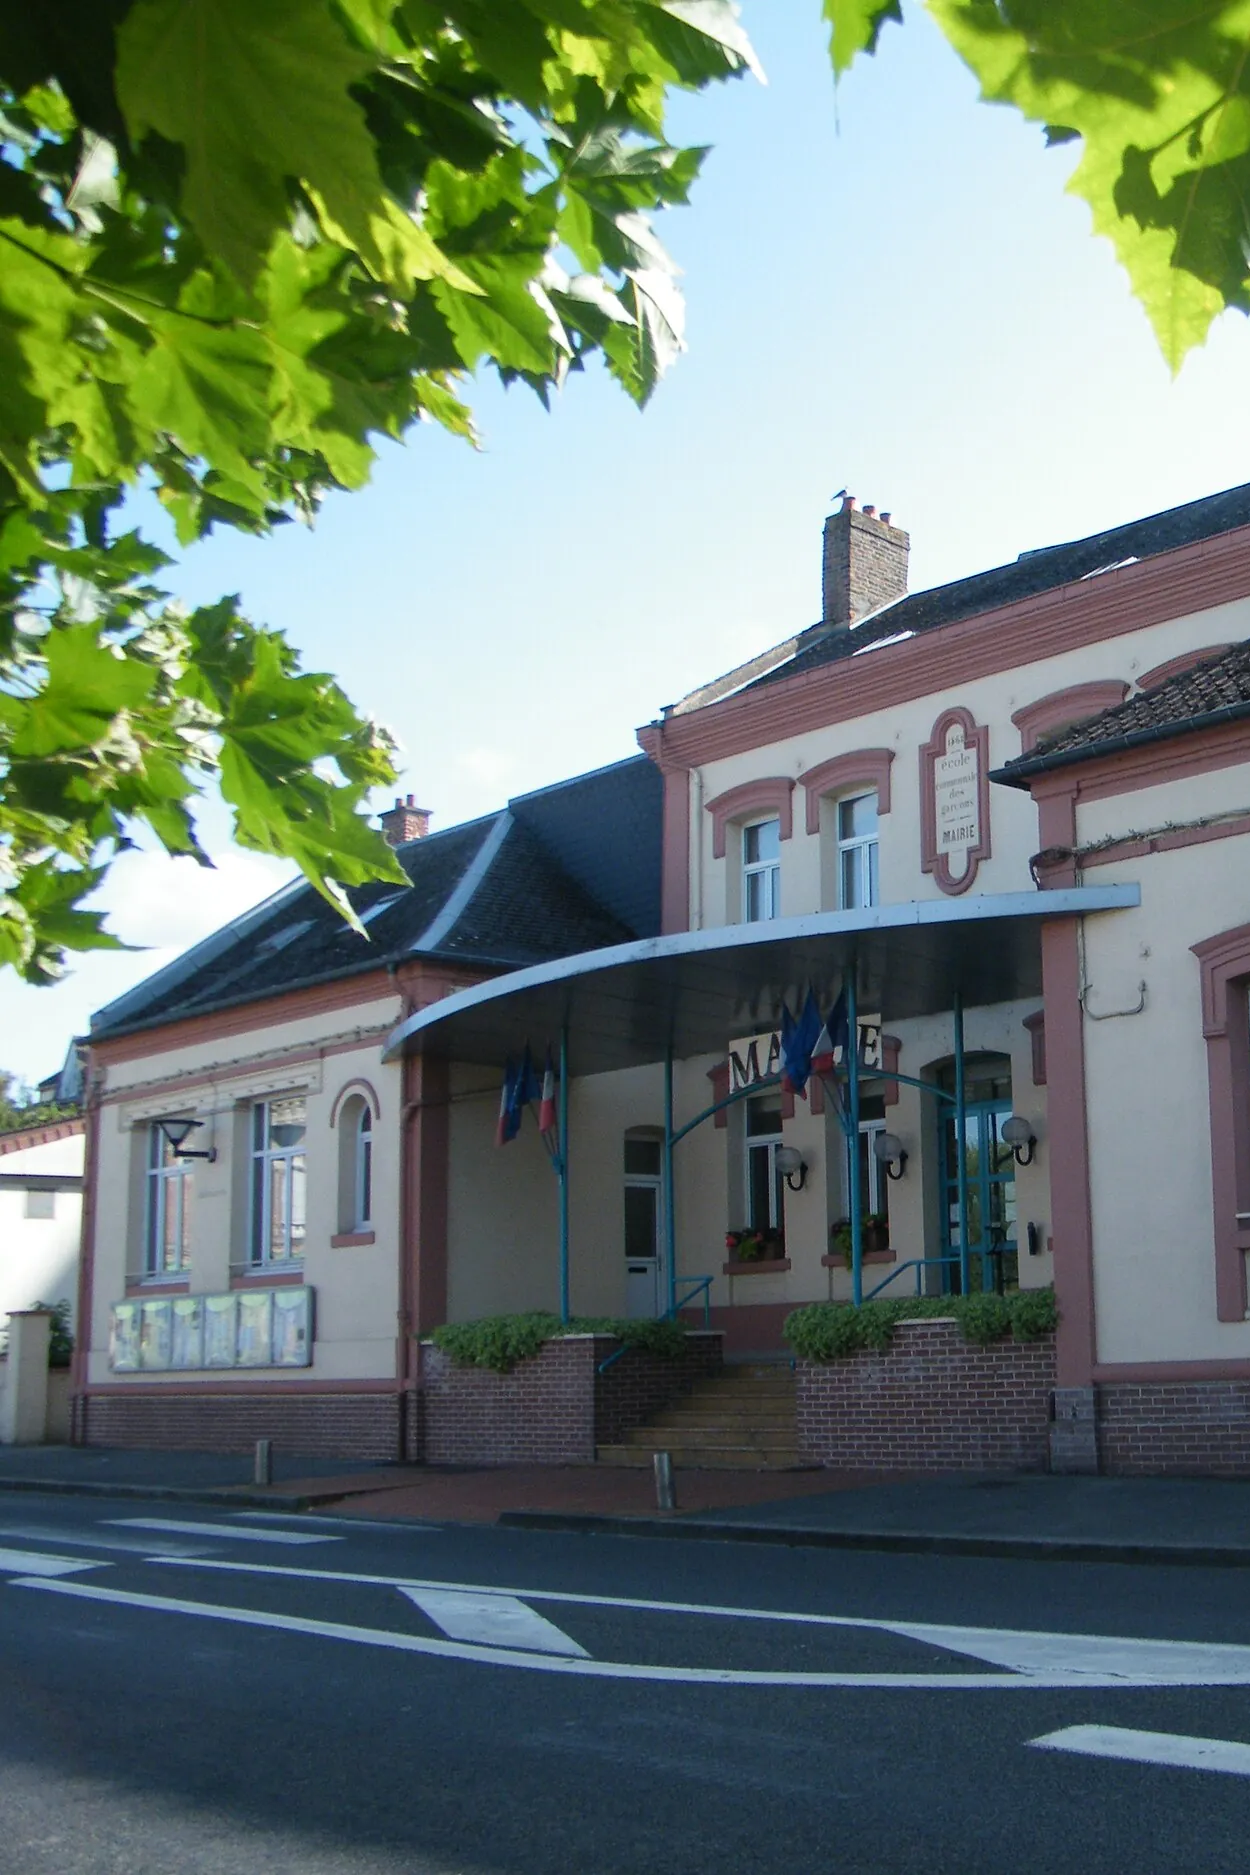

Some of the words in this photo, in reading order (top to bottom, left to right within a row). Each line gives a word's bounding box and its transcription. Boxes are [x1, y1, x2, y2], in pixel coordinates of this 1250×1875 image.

[949, 788, 965, 799] des
[943, 824, 975, 844] MAIRIE
[729, 1024, 881, 1093] MAE
